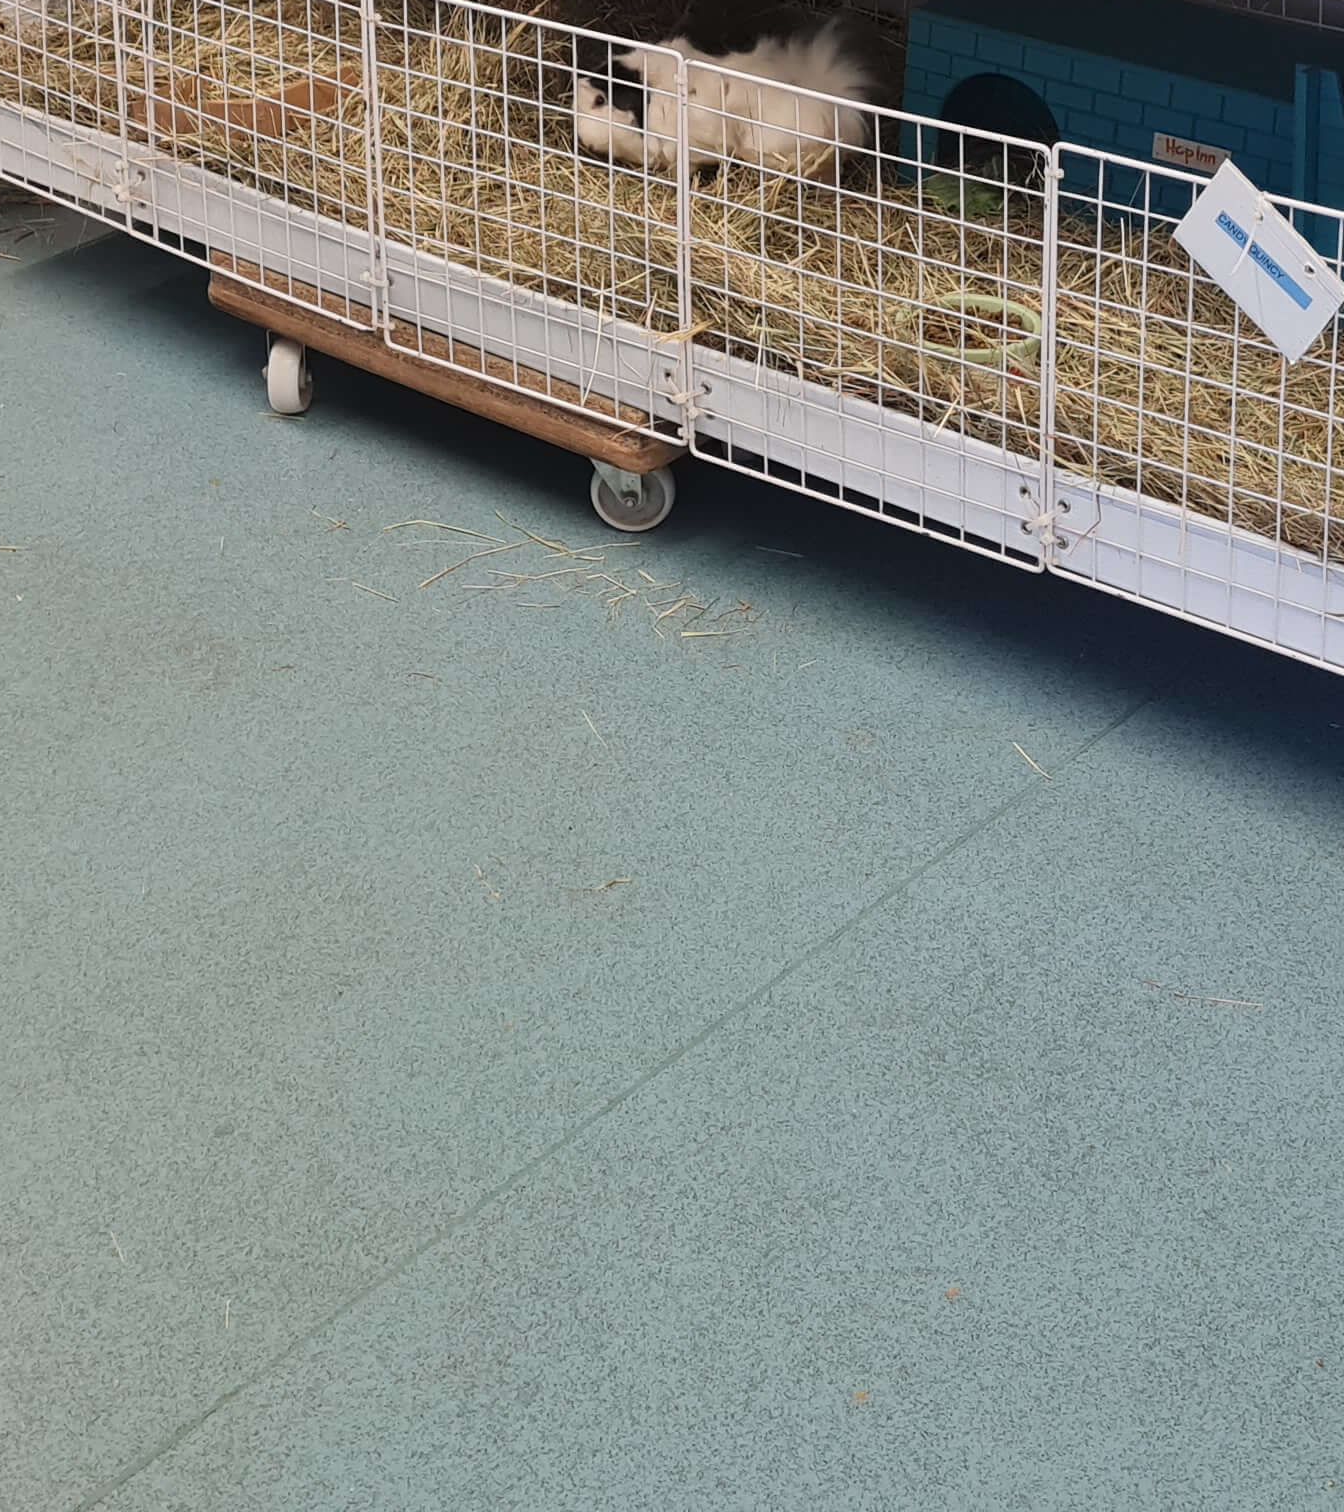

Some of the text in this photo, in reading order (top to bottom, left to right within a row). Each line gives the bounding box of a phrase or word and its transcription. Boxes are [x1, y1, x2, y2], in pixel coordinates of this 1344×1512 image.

[1165, 137, 1216, 165] Hop Inn
[1249, 242, 1286, 280] QUINCY
